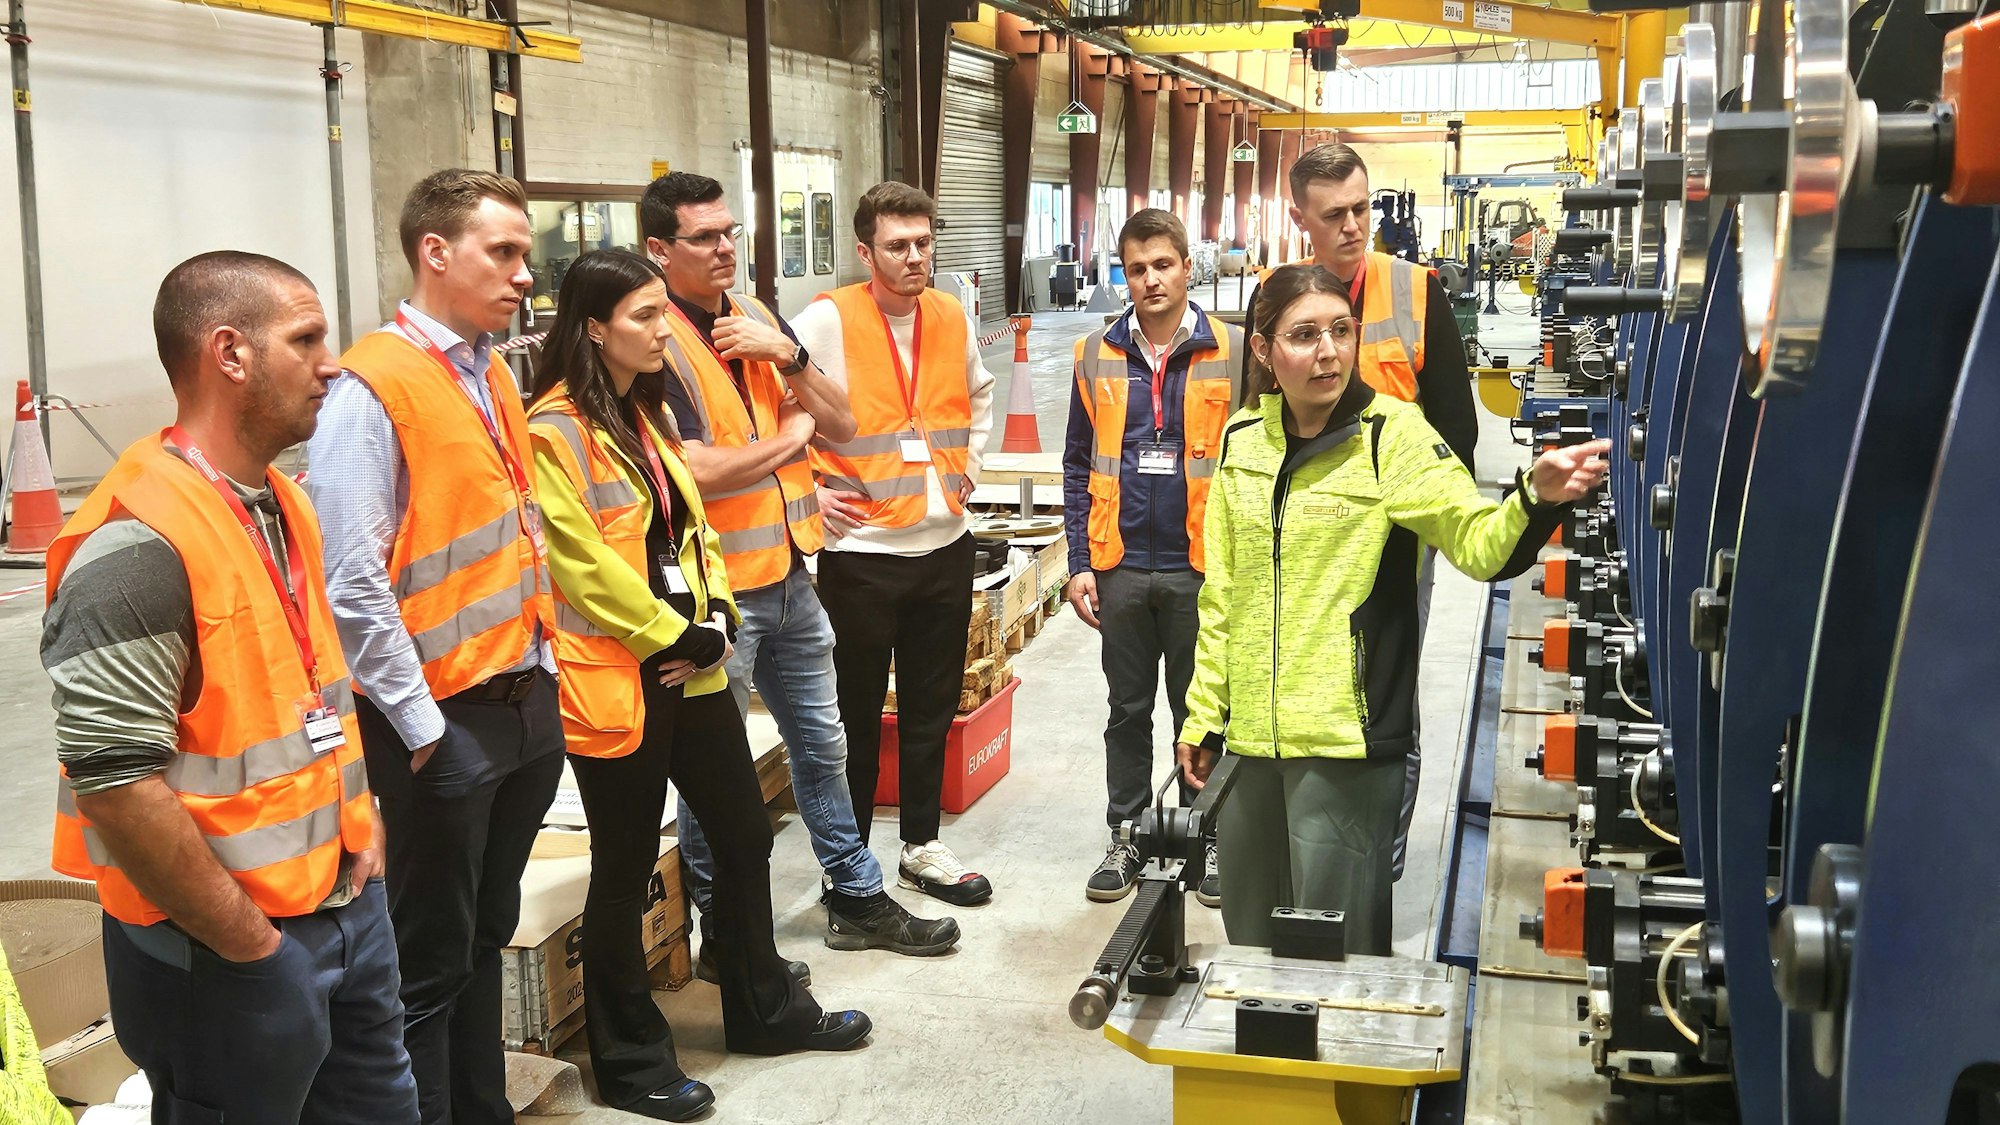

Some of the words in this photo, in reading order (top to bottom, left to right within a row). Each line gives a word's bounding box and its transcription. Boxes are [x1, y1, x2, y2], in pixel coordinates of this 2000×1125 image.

[1444, 6, 1455, 17] 500
[1455, 7, 1463, 20] kg
[968, 727, 1009, 776] EUROKRAFT
[566, 981, 585, 1005] 202
